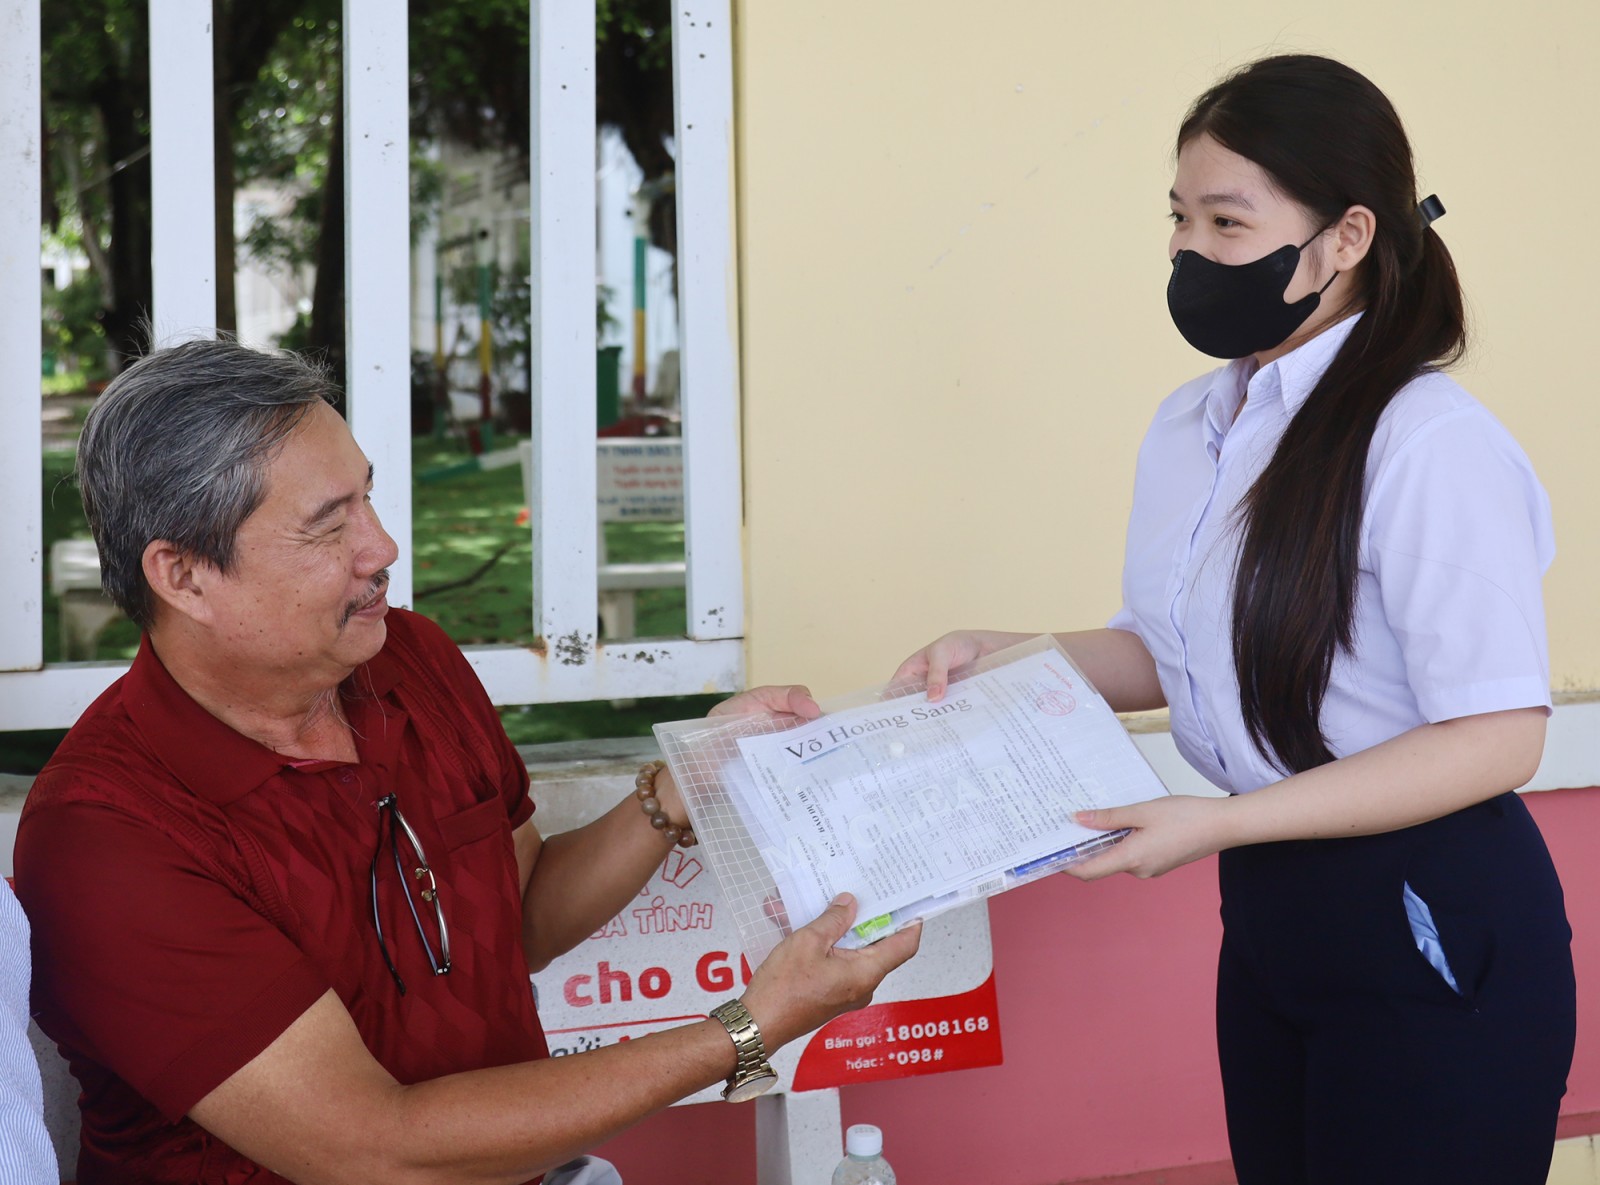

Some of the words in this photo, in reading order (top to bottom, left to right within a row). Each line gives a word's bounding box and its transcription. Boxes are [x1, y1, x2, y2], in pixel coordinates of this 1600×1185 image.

[785, 737, 823, 760] Võ
[827, 714, 909, 745] Hoàng
[910, 698, 973, 722] Sang
[633, 896, 713, 935] TÍNH
[563, 961, 672, 1008] cho
[885, 1016, 989, 1042] 18008168
